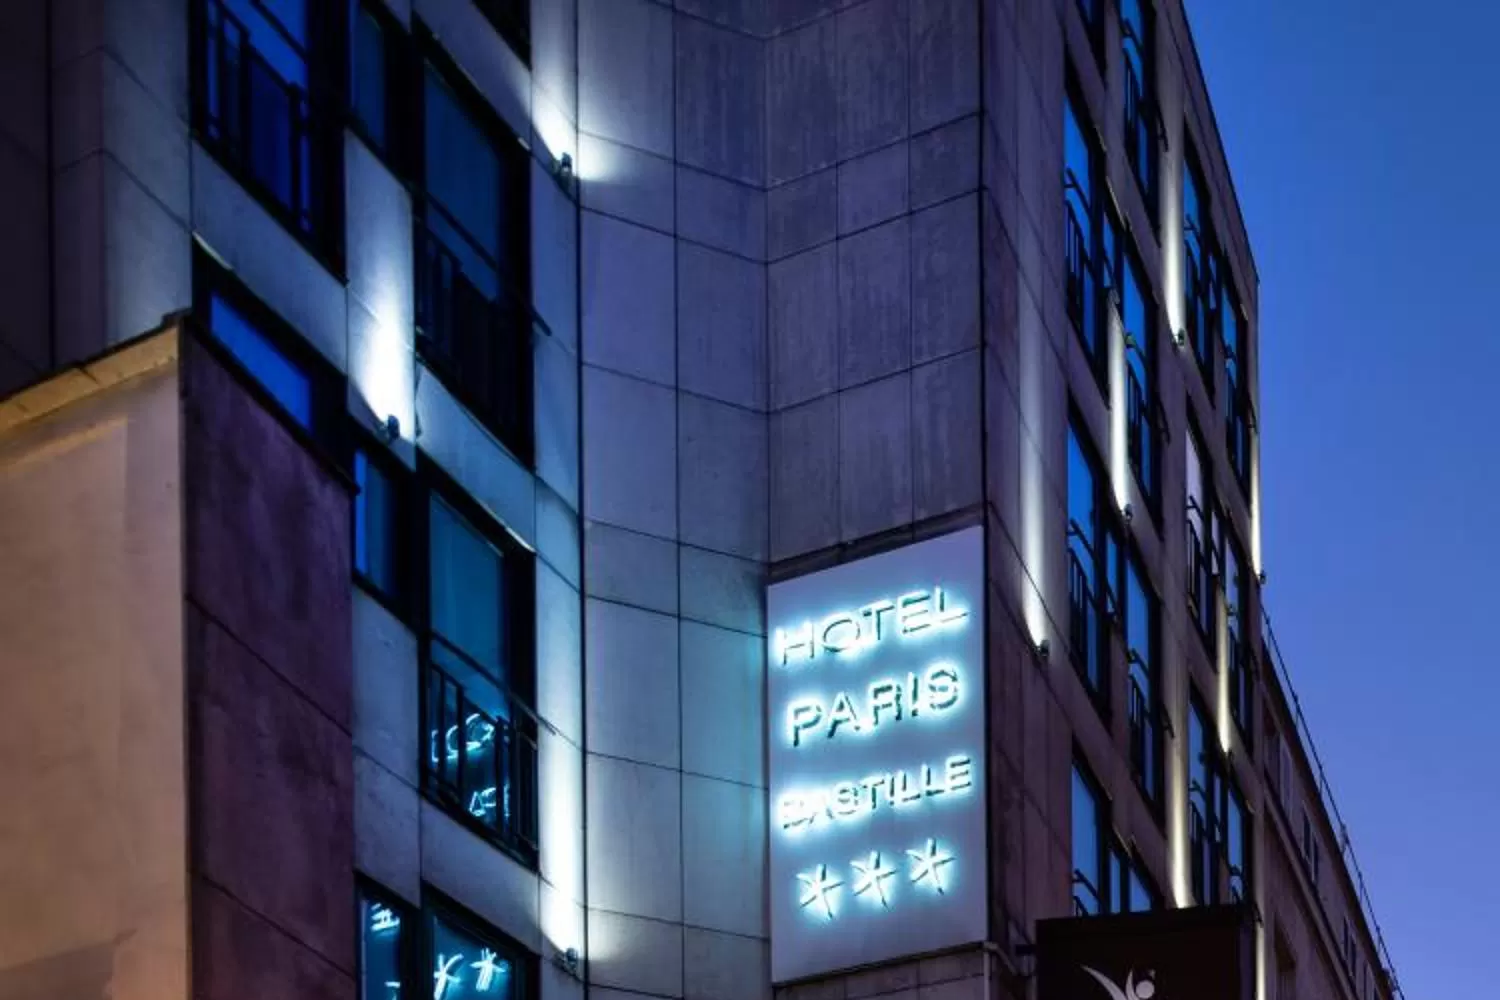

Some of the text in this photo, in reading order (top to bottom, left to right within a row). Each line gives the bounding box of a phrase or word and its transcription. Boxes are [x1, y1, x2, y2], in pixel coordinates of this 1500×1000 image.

[776, 585, 968, 666] HOTEL
[787, 666, 959, 747] PARIS
[781, 756, 972, 830] BASTILLE
